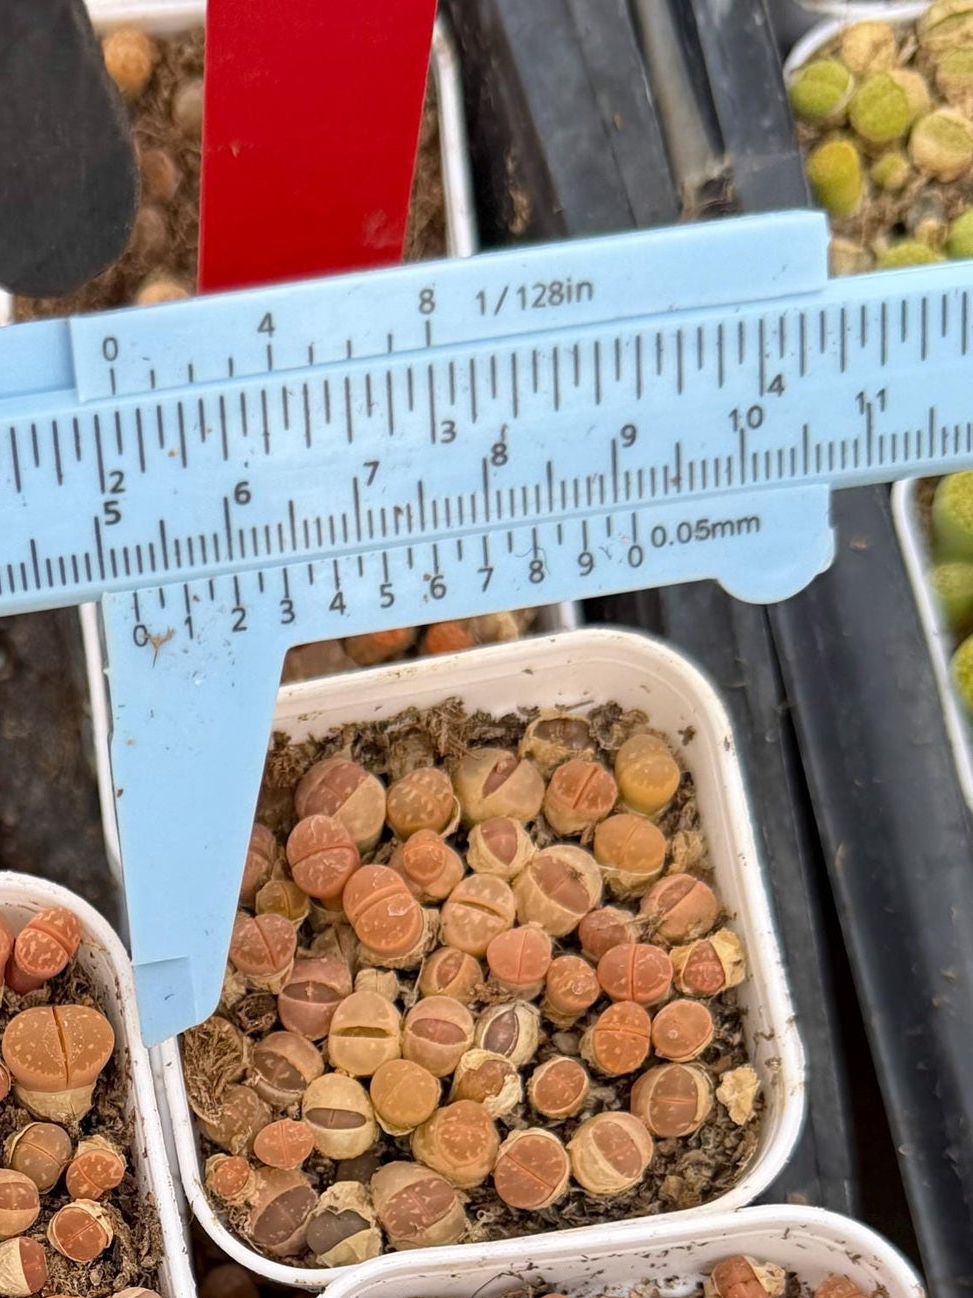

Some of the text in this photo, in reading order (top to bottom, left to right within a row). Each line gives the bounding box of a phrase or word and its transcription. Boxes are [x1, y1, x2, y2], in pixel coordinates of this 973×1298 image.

[102, 336, 119, 361] 0
[257, 312, 275, 338] 4
[419, 288, 436, 315] 8
[104, 502, 122, 525] 5
[233, 482, 251, 505] 6
[363, 461, 380, 486] 7
[491, 444, 508, 466] 8
[620, 424, 637, 448] 9
[728, 405, 764, 431] 10
[855, 389, 887, 415] 11
[108, 471, 126, 493] 2
[440, 421, 457, 443] 3
[768, 374, 785, 396] 4
[133, 516, 761, 647] 0 1 2 3 4 5 6 7 8 9 0 0.05mm
